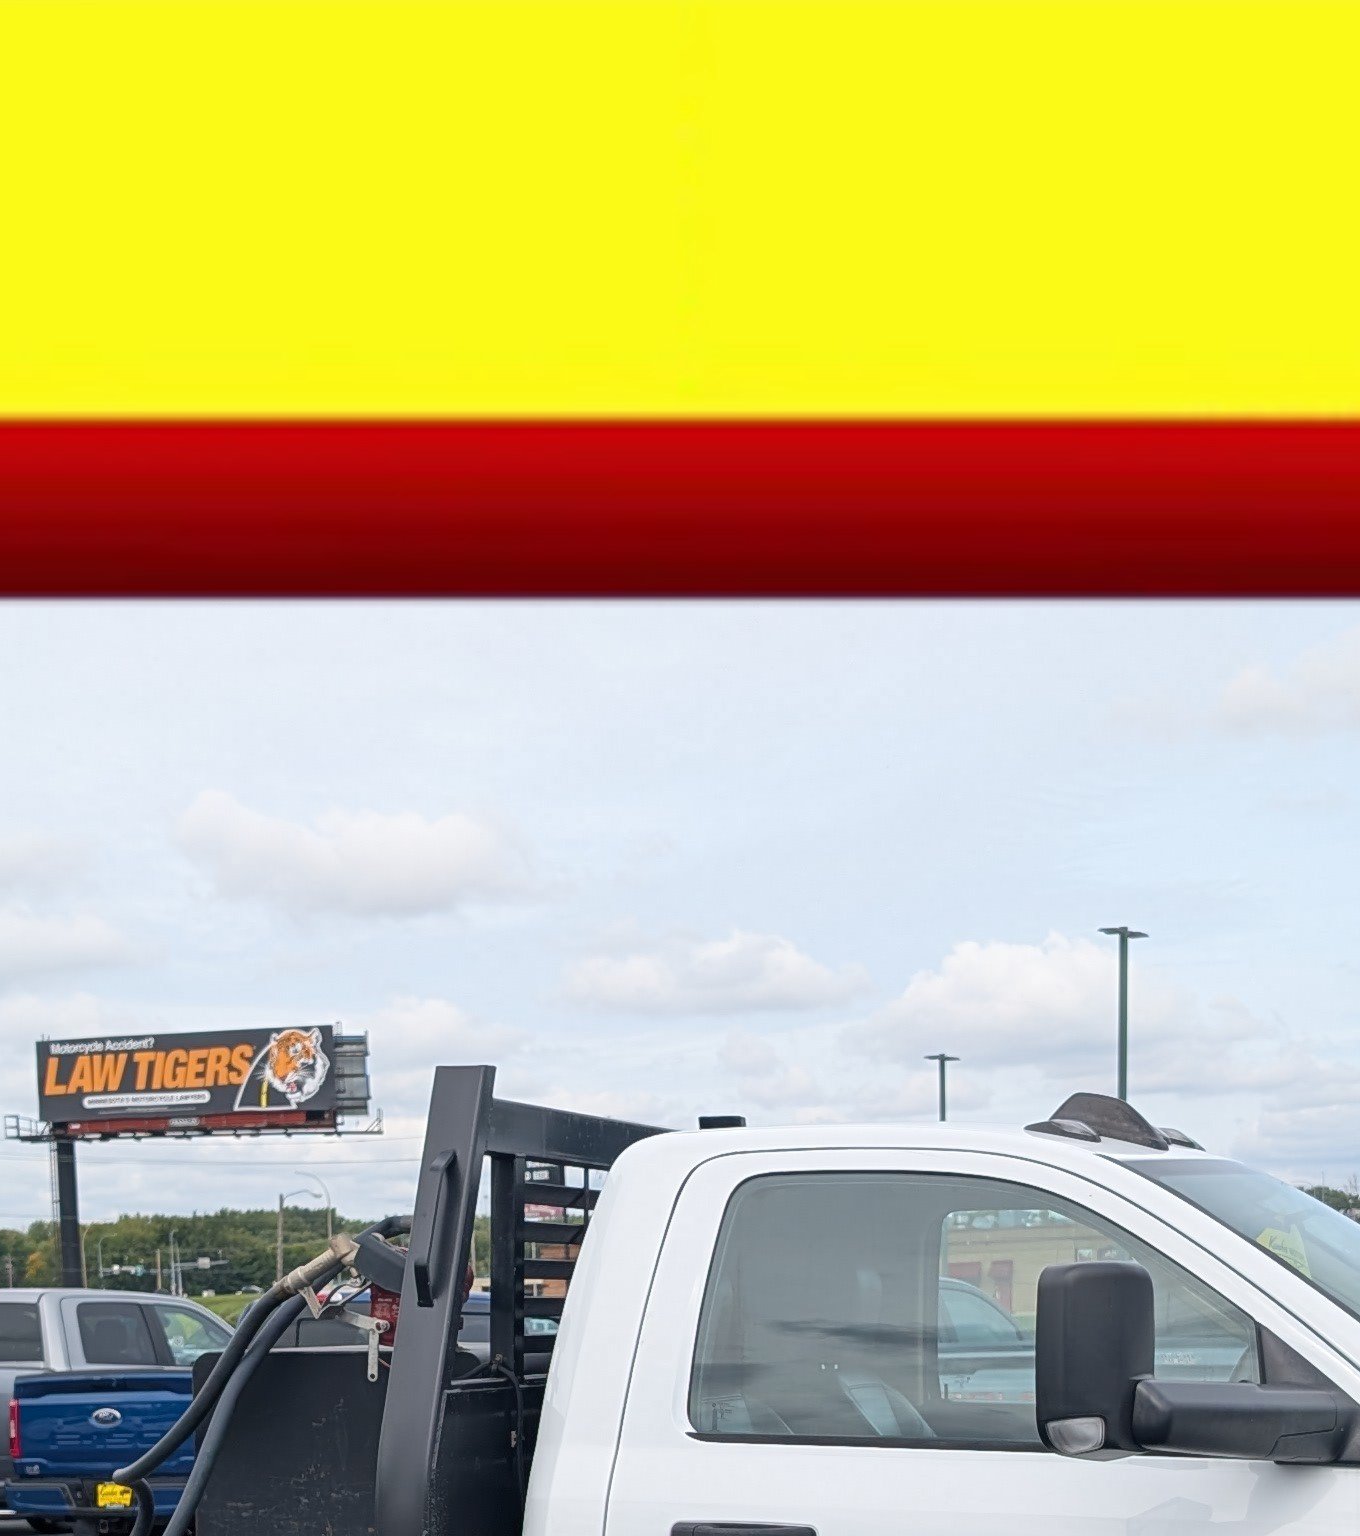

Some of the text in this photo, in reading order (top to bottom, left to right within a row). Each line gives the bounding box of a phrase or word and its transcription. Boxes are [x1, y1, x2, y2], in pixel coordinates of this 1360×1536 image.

[49, 1036, 155, 1055] Motorcycle Accident?
[45, 1044, 255, 1096] LAW TIGERS
